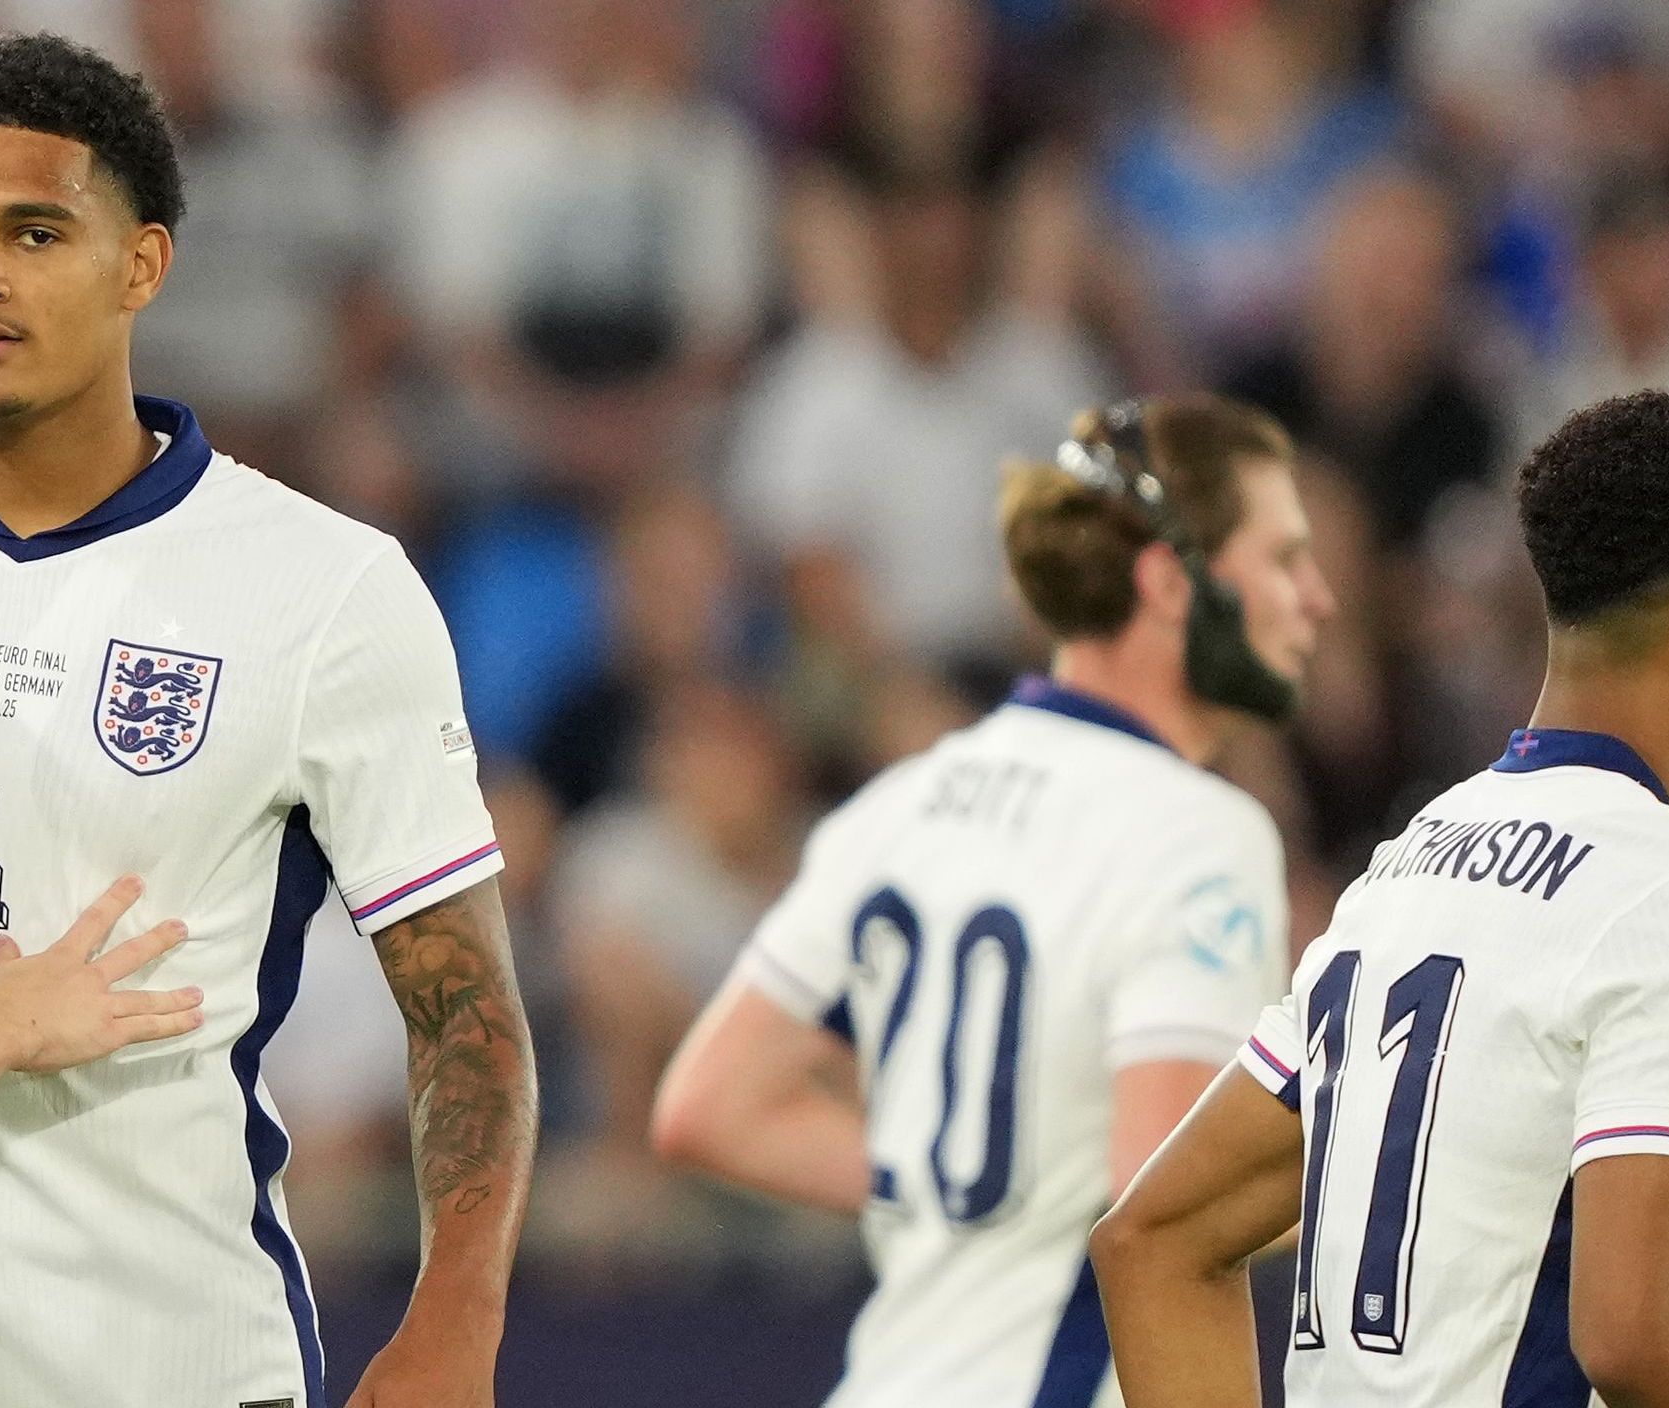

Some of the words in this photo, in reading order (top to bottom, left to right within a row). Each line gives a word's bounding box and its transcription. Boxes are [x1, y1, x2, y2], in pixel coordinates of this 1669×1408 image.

[4, 672, 63, 698] GERMANY
[33, 649, 67, 672] FINAL
[850, 885, 1031, 1224] 20
[1293, 949, 1465, 1355] 11
